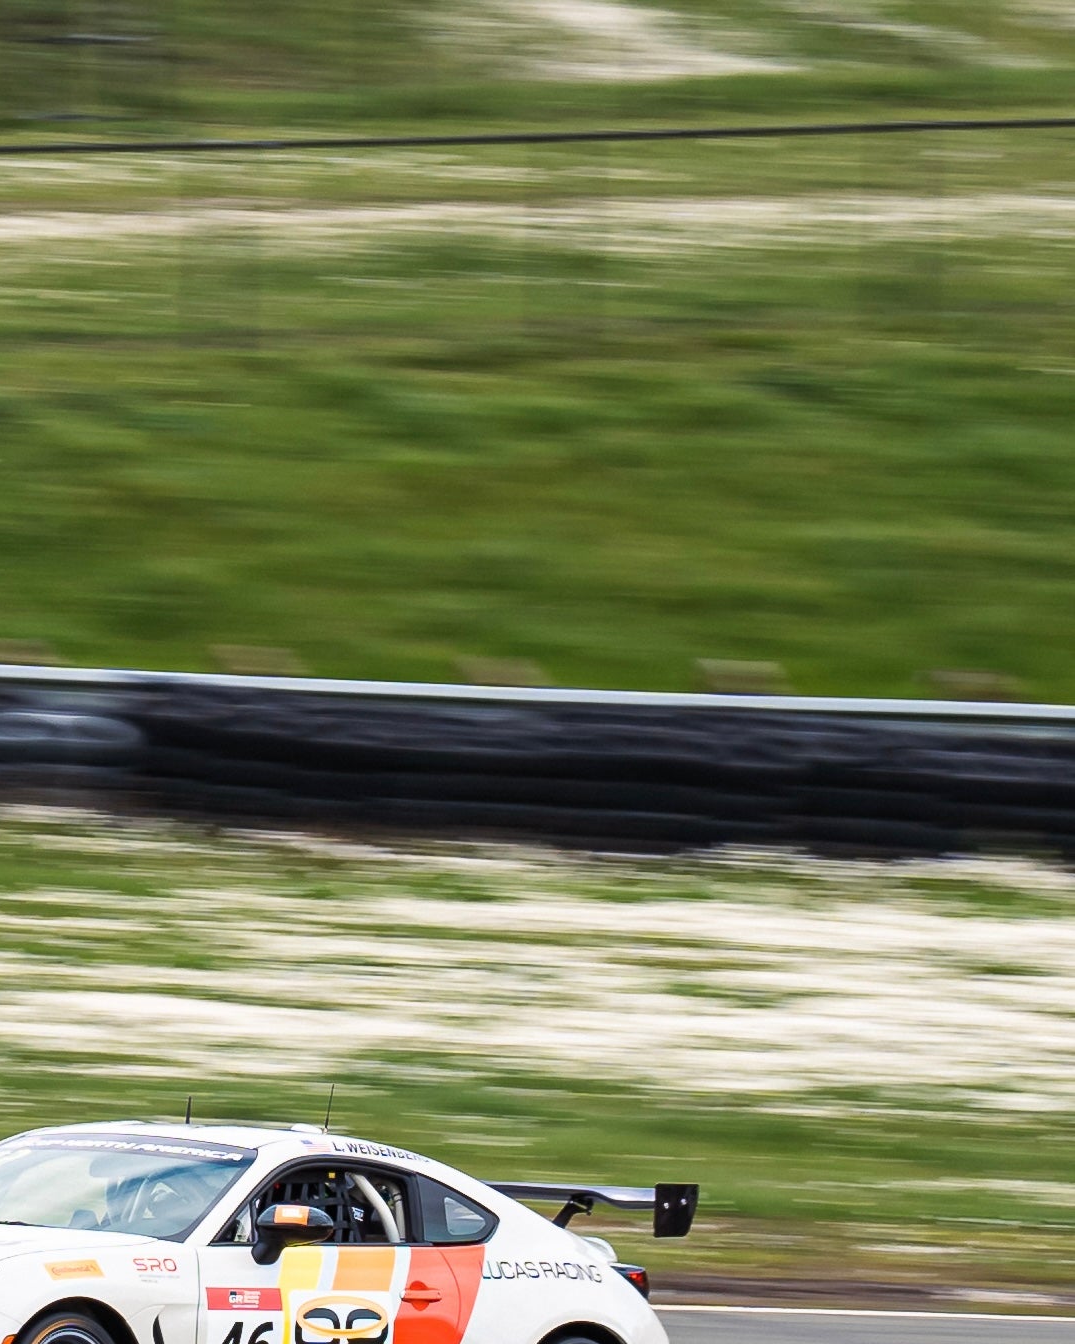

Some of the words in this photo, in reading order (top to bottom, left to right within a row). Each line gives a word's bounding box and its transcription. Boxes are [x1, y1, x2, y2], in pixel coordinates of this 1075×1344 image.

[332, 1141, 345, 1152] L.
[133, 1258, 178, 1272] SRO
[480, 1261, 540, 1279] LUCAS
[539, 1262, 603, 1283] RACING
